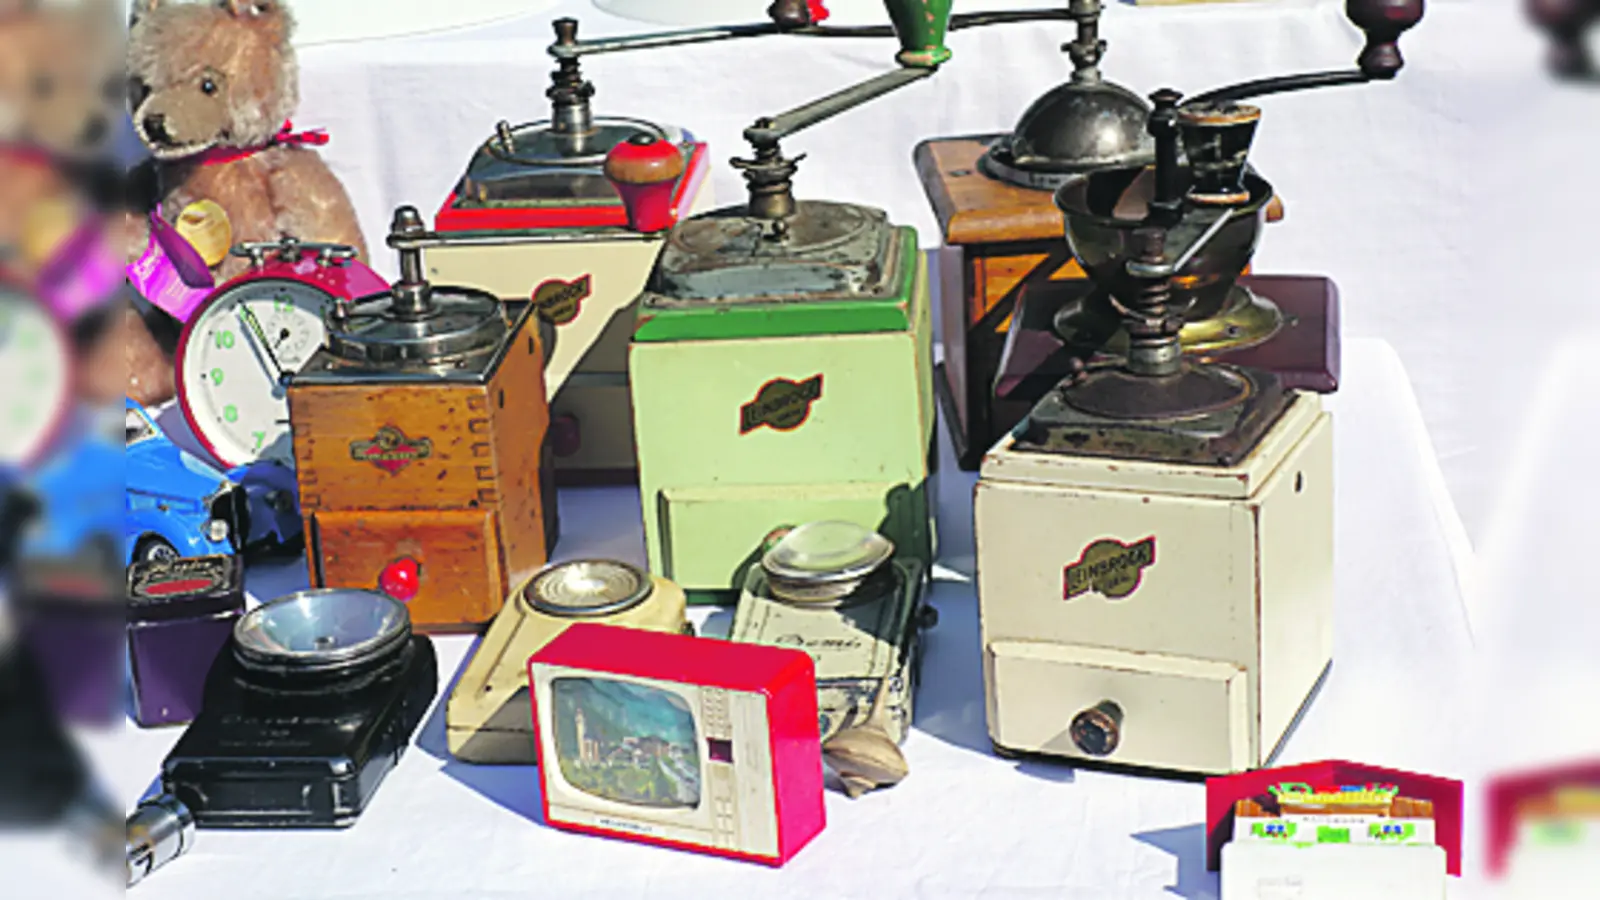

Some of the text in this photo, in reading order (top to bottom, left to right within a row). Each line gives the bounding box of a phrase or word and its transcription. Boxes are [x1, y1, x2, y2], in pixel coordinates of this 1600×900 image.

[274, 294, 294, 314] 12
[215, 330, 235, 349] 10
[210, 367, 225, 386] 9
[252, 430, 266, 449] 7
